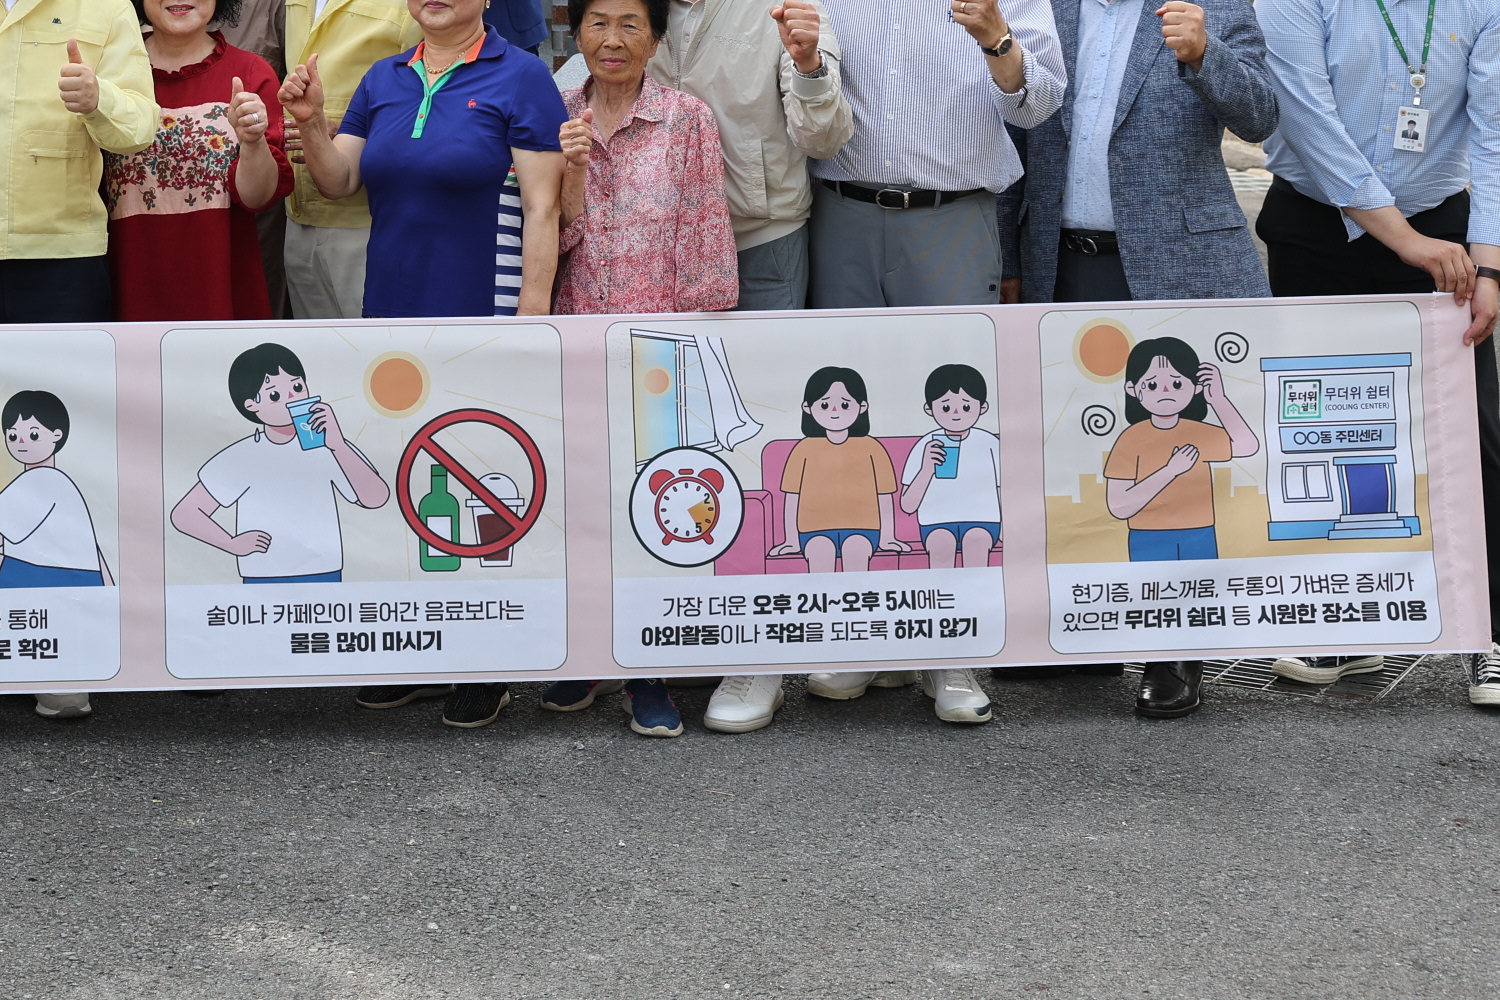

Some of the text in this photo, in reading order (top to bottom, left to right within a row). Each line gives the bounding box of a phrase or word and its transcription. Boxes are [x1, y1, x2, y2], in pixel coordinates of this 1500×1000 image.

[1287, 391, 1318, 403] 무더위
[1324, 385, 1390, 401] 무더위 쉼터
[1301, 402, 1318, 412] 쉼터
[1324, 402, 1390, 412] (COOLING CENTER)
[1335, 429, 1383, 444] 주민센터
[703, 492, 711, 505] 2
[695, 522, 703, 534] 5
[1071, 571, 1415, 605] 현기증, 메스꺼움, 두통의 가벼운 증세가
[206, 600, 525, 626] 술이나 카페인이 들어간 음료보다는
[662, 588, 956, 618] 가장 더운 오후 2시~오후 5시에는
[8, 608, 49, 631] 통해
[1062, 599, 1429, 633] 있으면 무더위 쉼터 등 시원한 장소를 이용
[290, 630, 442, 654] 물을 많이 마시기
[640, 616, 978, 647] 야외활동이나 작업을 되도록 하지 않기
[18, 637, 59, 660] 확인
